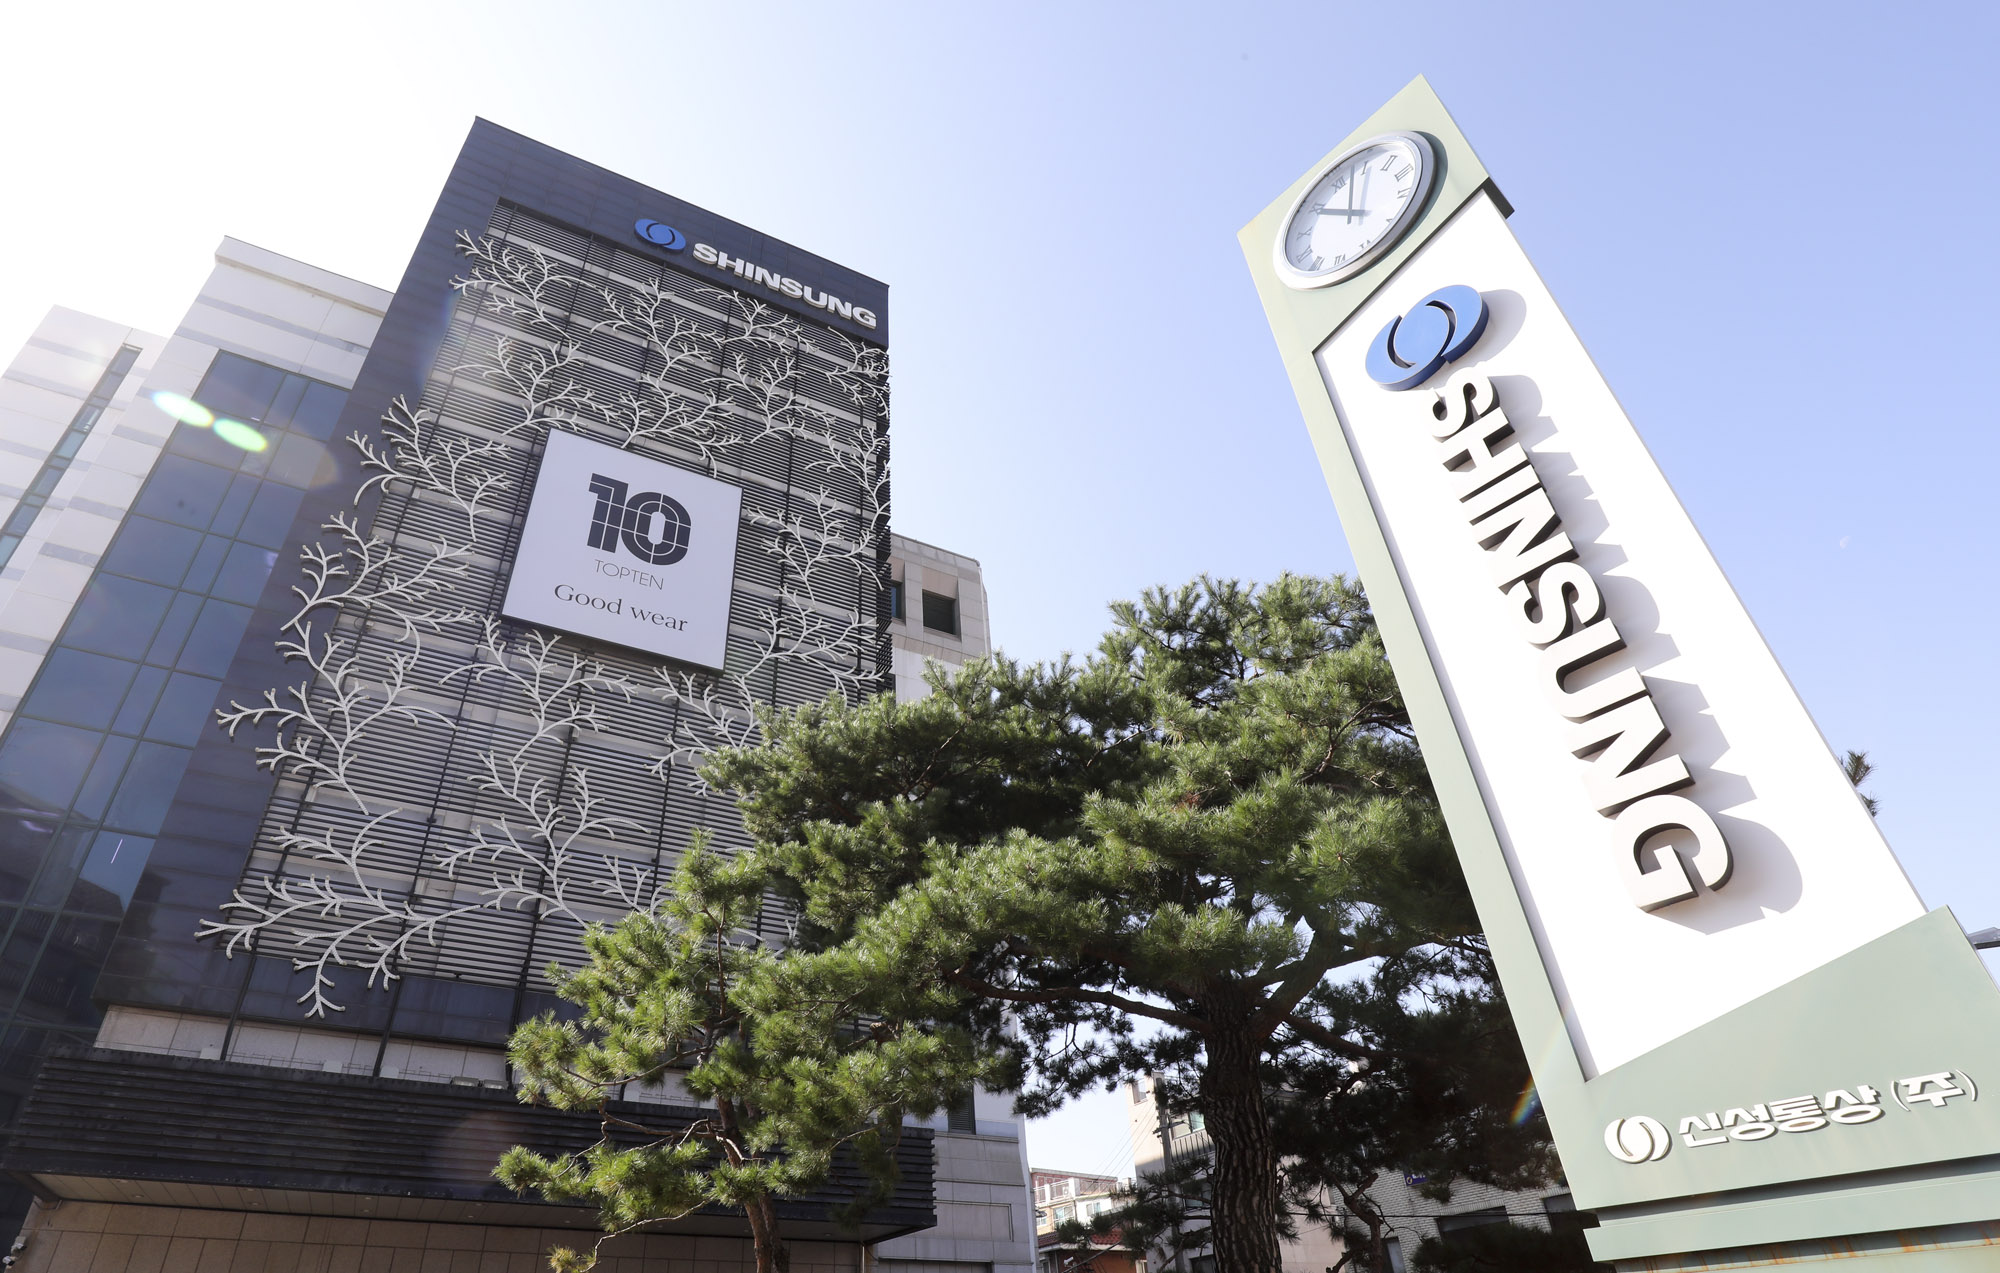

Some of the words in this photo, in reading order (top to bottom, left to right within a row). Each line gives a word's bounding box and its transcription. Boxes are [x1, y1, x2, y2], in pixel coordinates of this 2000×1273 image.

[692, 242, 878, 331] SHINSUNG
[586, 472, 692, 566] 10
[554, 583, 623, 616] Good
[630, 604, 689, 632] wear
[594, 558, 664, 591] TOPTEN
[1431, 366, 1735, 914] SHINSUNG
[1678, 1084, 1885, 1148] 신성통상
[1890, 1068, 1979, 1112] (주)
